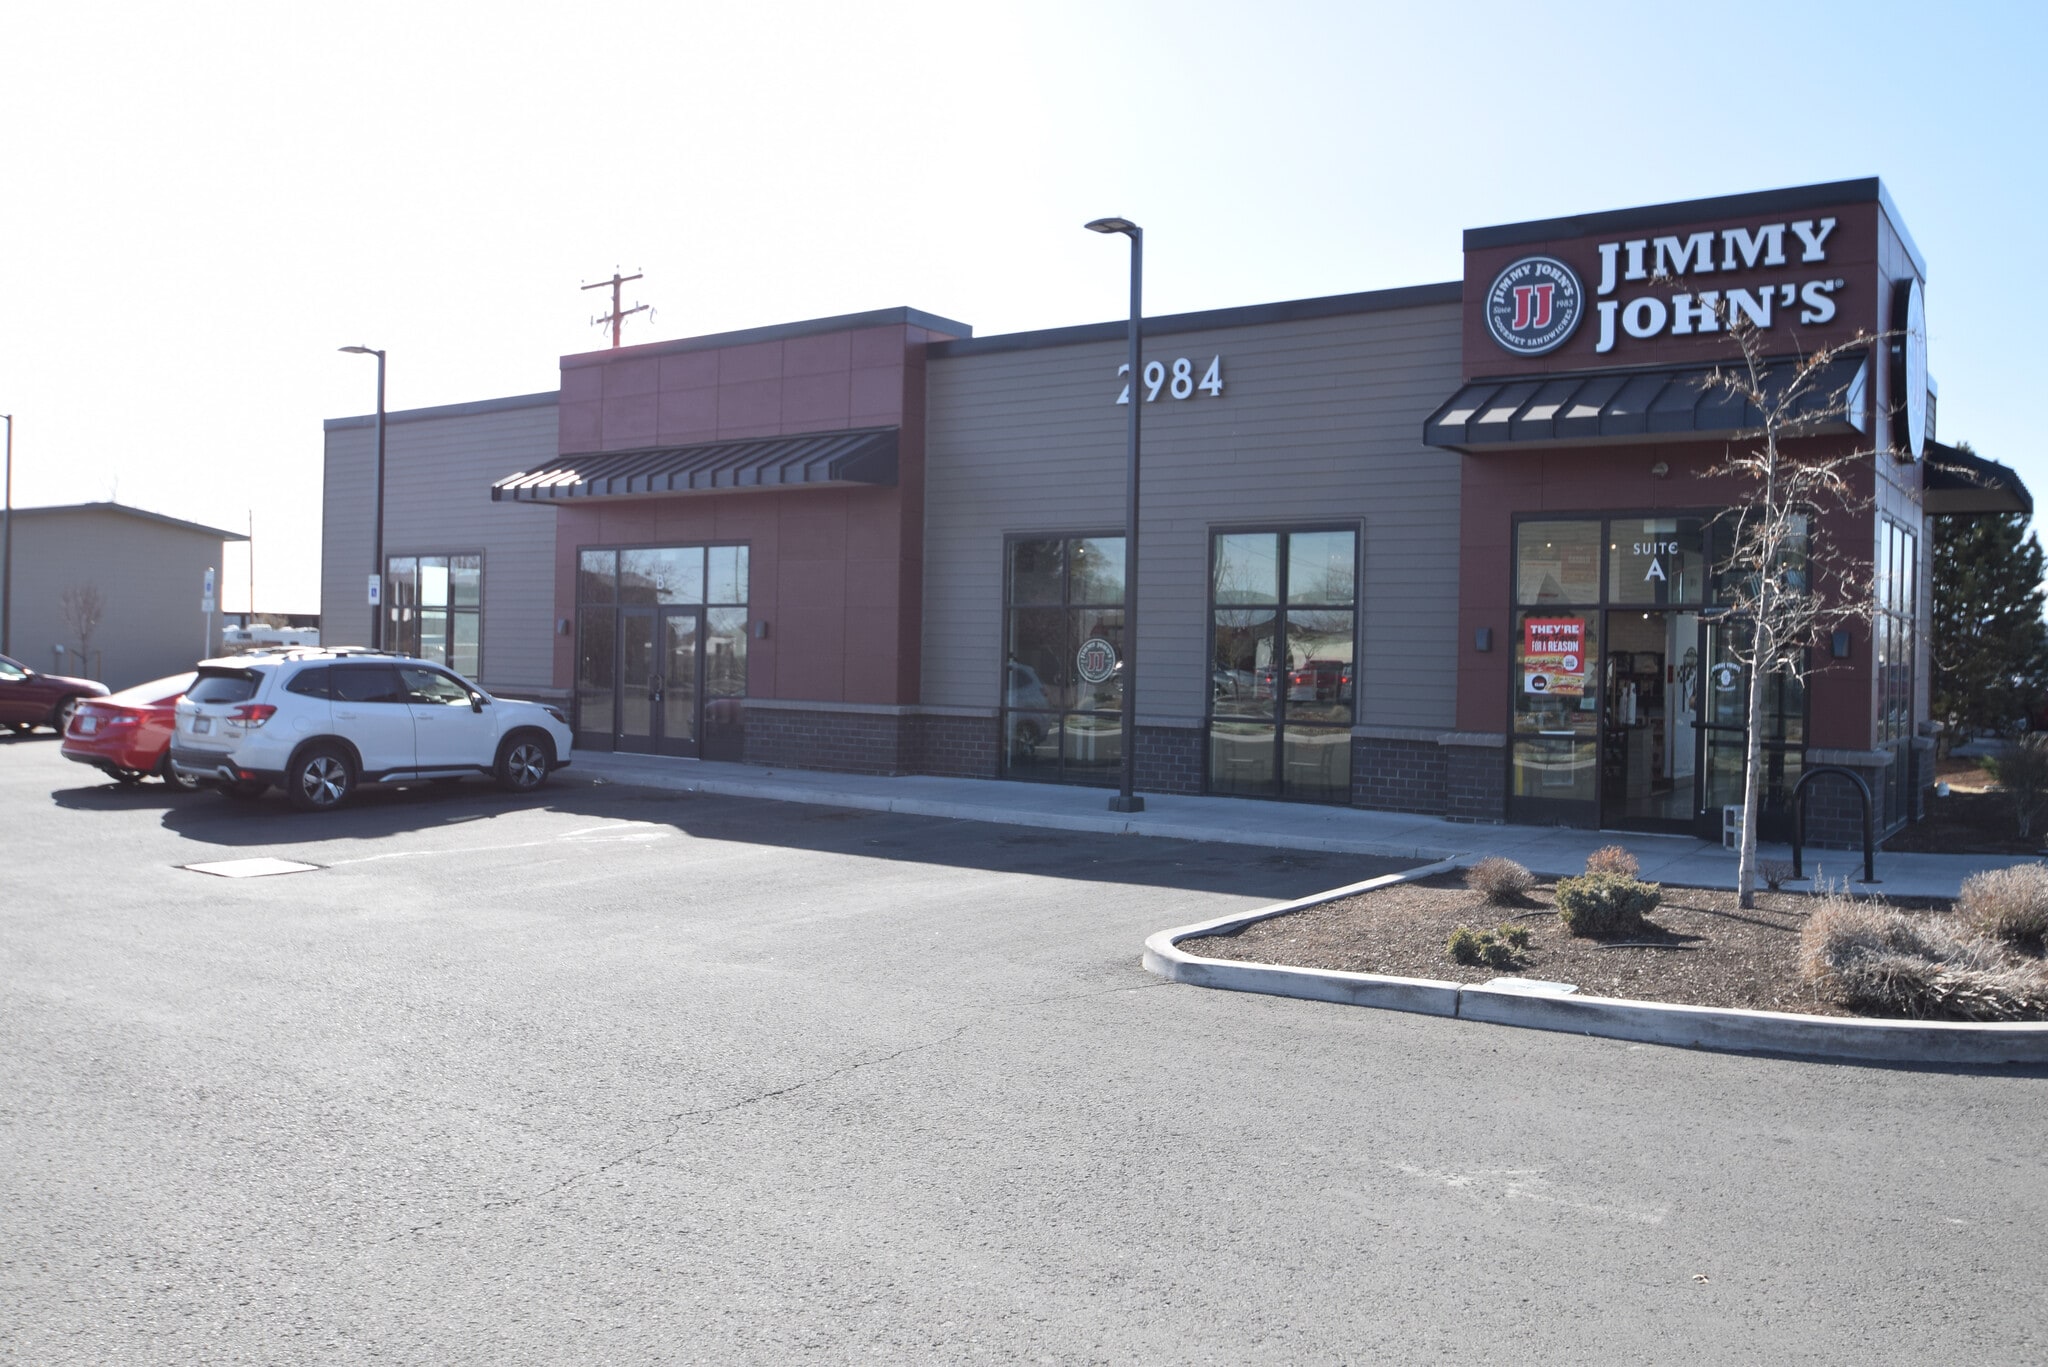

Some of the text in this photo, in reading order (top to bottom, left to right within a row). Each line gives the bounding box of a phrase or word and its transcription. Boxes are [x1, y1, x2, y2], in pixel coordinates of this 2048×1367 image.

[1597, 217, 1836, 295] JIMMY
[1493, 263, 1574, 304] JIMMY JOHN'S
[1512, 282, 1555, 331] JJ
[1596, 278, 1837, 353] JOHN'S
[1633, 541, 1679, 556] SUITE
[1643, 557, 1667, 581] A
[1530, 624, 1580, 635] THEY'RE
[1531, 640, 1579, 653] FOR A REASON
